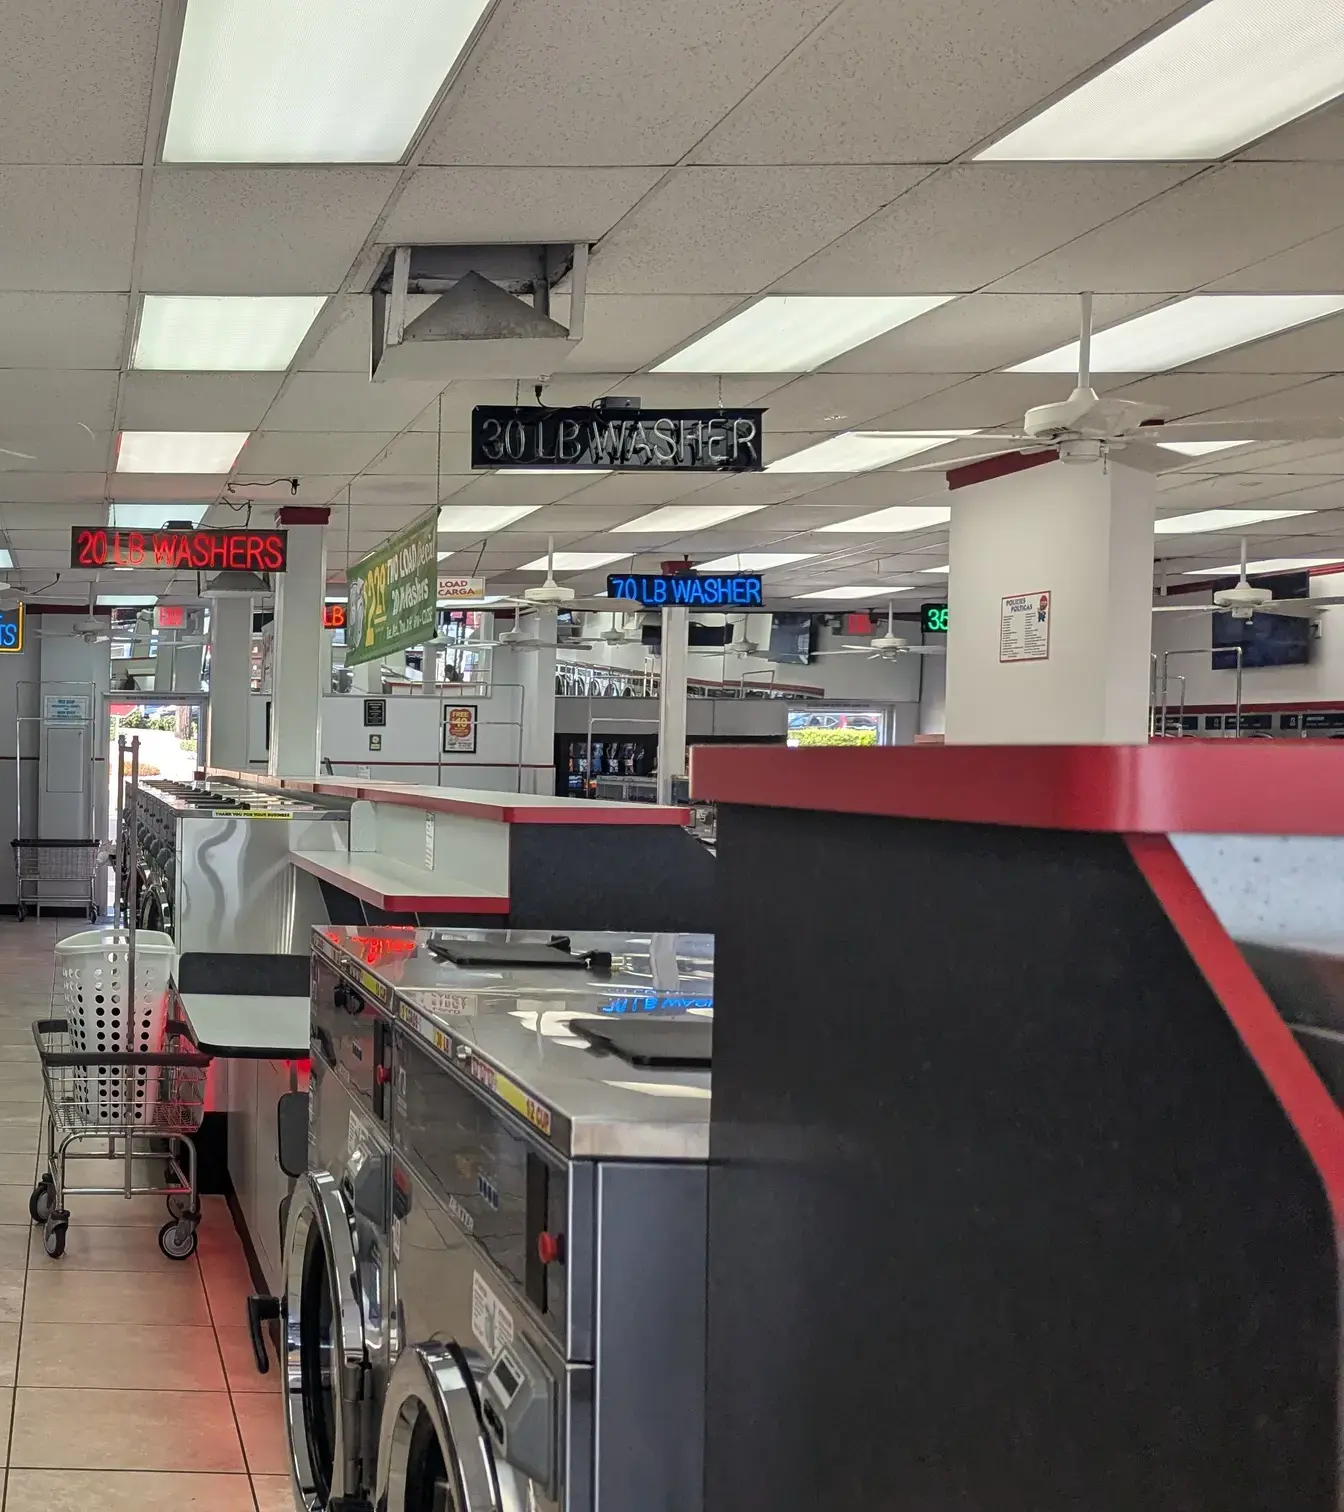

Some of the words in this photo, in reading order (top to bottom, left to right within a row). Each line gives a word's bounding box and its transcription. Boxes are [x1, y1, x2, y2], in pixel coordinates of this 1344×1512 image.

[482, 418, 526, 461] 30
[538, 418, 582, 461] LB
[588, 417, 758, 464] WASHER
[77, 531, 107, 566] 20
[113, 532, 146, 567] LB
[152, 533, 284, 570] WASHERS
[437, 588, 475, 597] CARGA
[439, 579, 468, 589] LOAD
[611, 578, 637, 601] 70
[642, 578, 668, 604] LB
[671, 578, 762, 604] WASHER
[323, 604, 345, 627] LB
